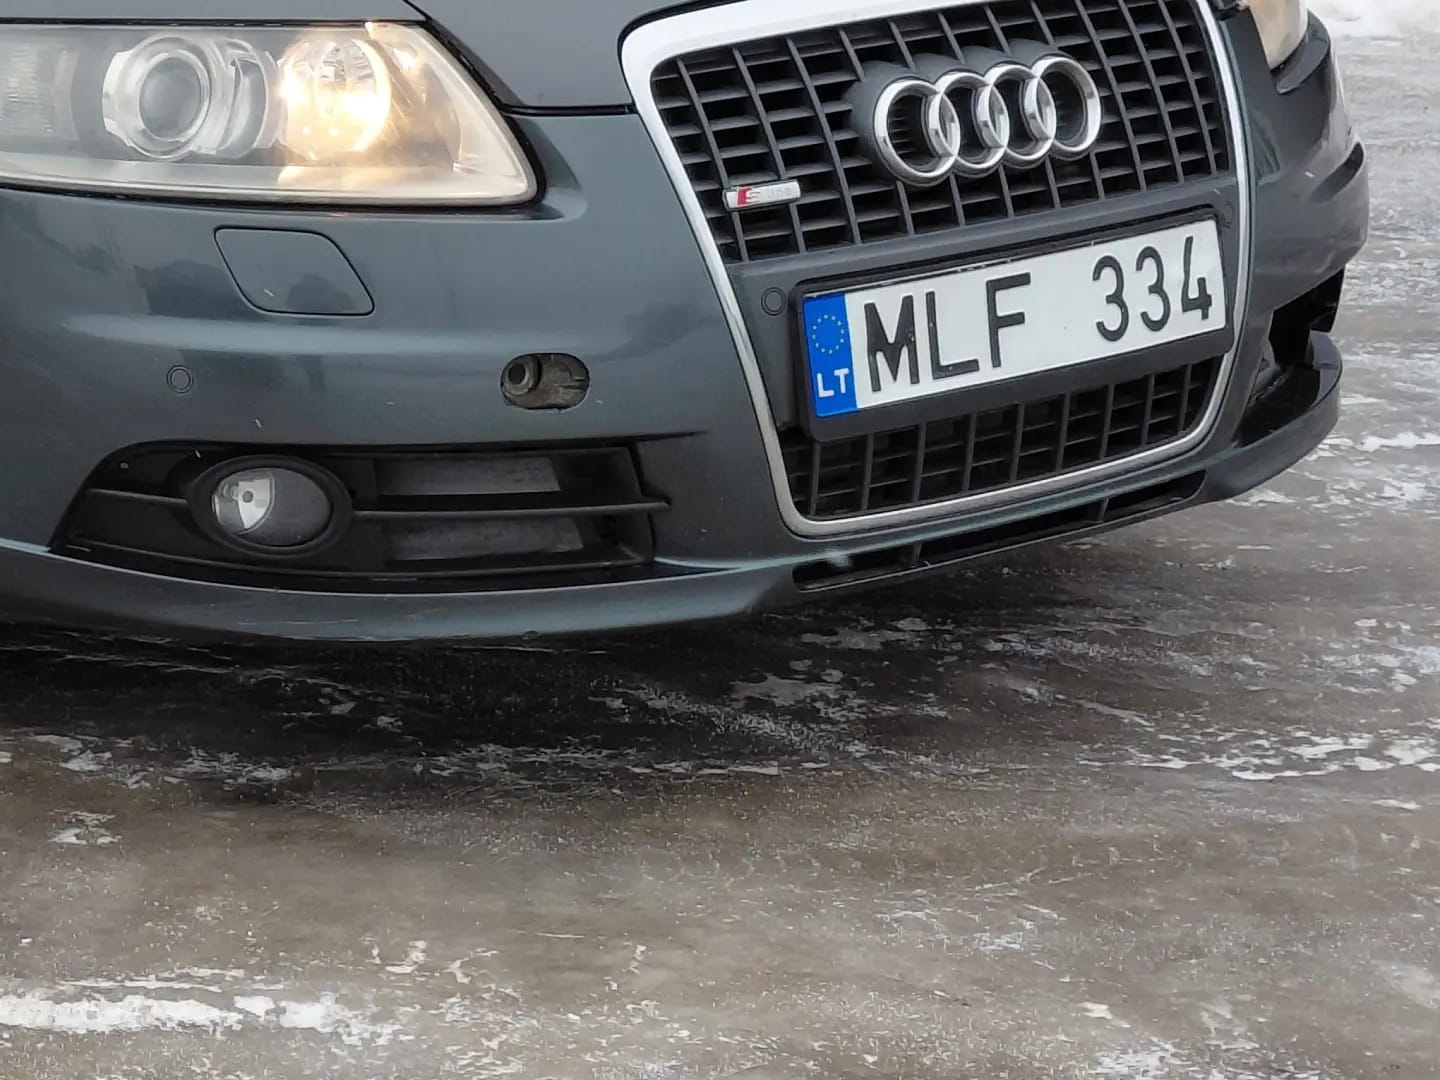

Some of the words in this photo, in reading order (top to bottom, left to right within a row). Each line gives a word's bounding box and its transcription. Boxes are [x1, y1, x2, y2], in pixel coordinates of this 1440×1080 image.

[864, 272, 1032, 393] MLF
[1092, 235, 1213, 342] 334
[816, 367, 850, 398] LT
